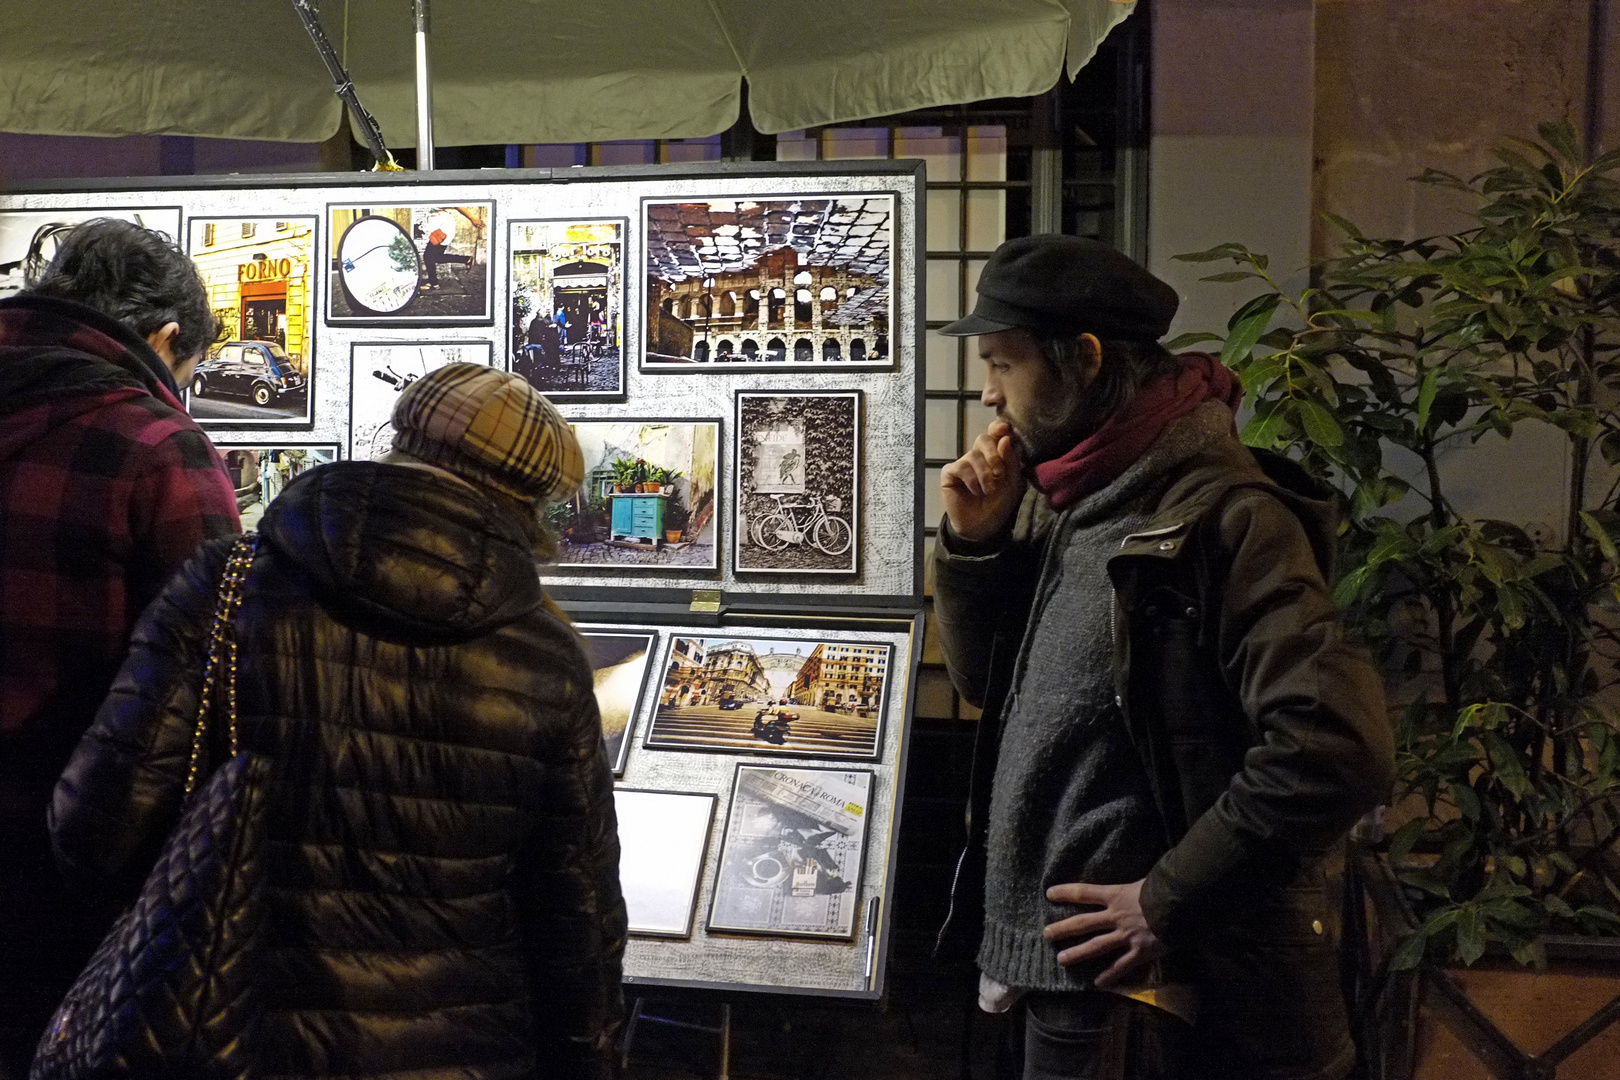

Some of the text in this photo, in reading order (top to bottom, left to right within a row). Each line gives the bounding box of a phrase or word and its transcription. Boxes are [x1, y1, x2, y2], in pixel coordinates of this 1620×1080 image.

[237, 258, 291, 282] FORNO
[774, 771, 815, 795] CRONACA
[820, 791, 846, 808] ROMA
